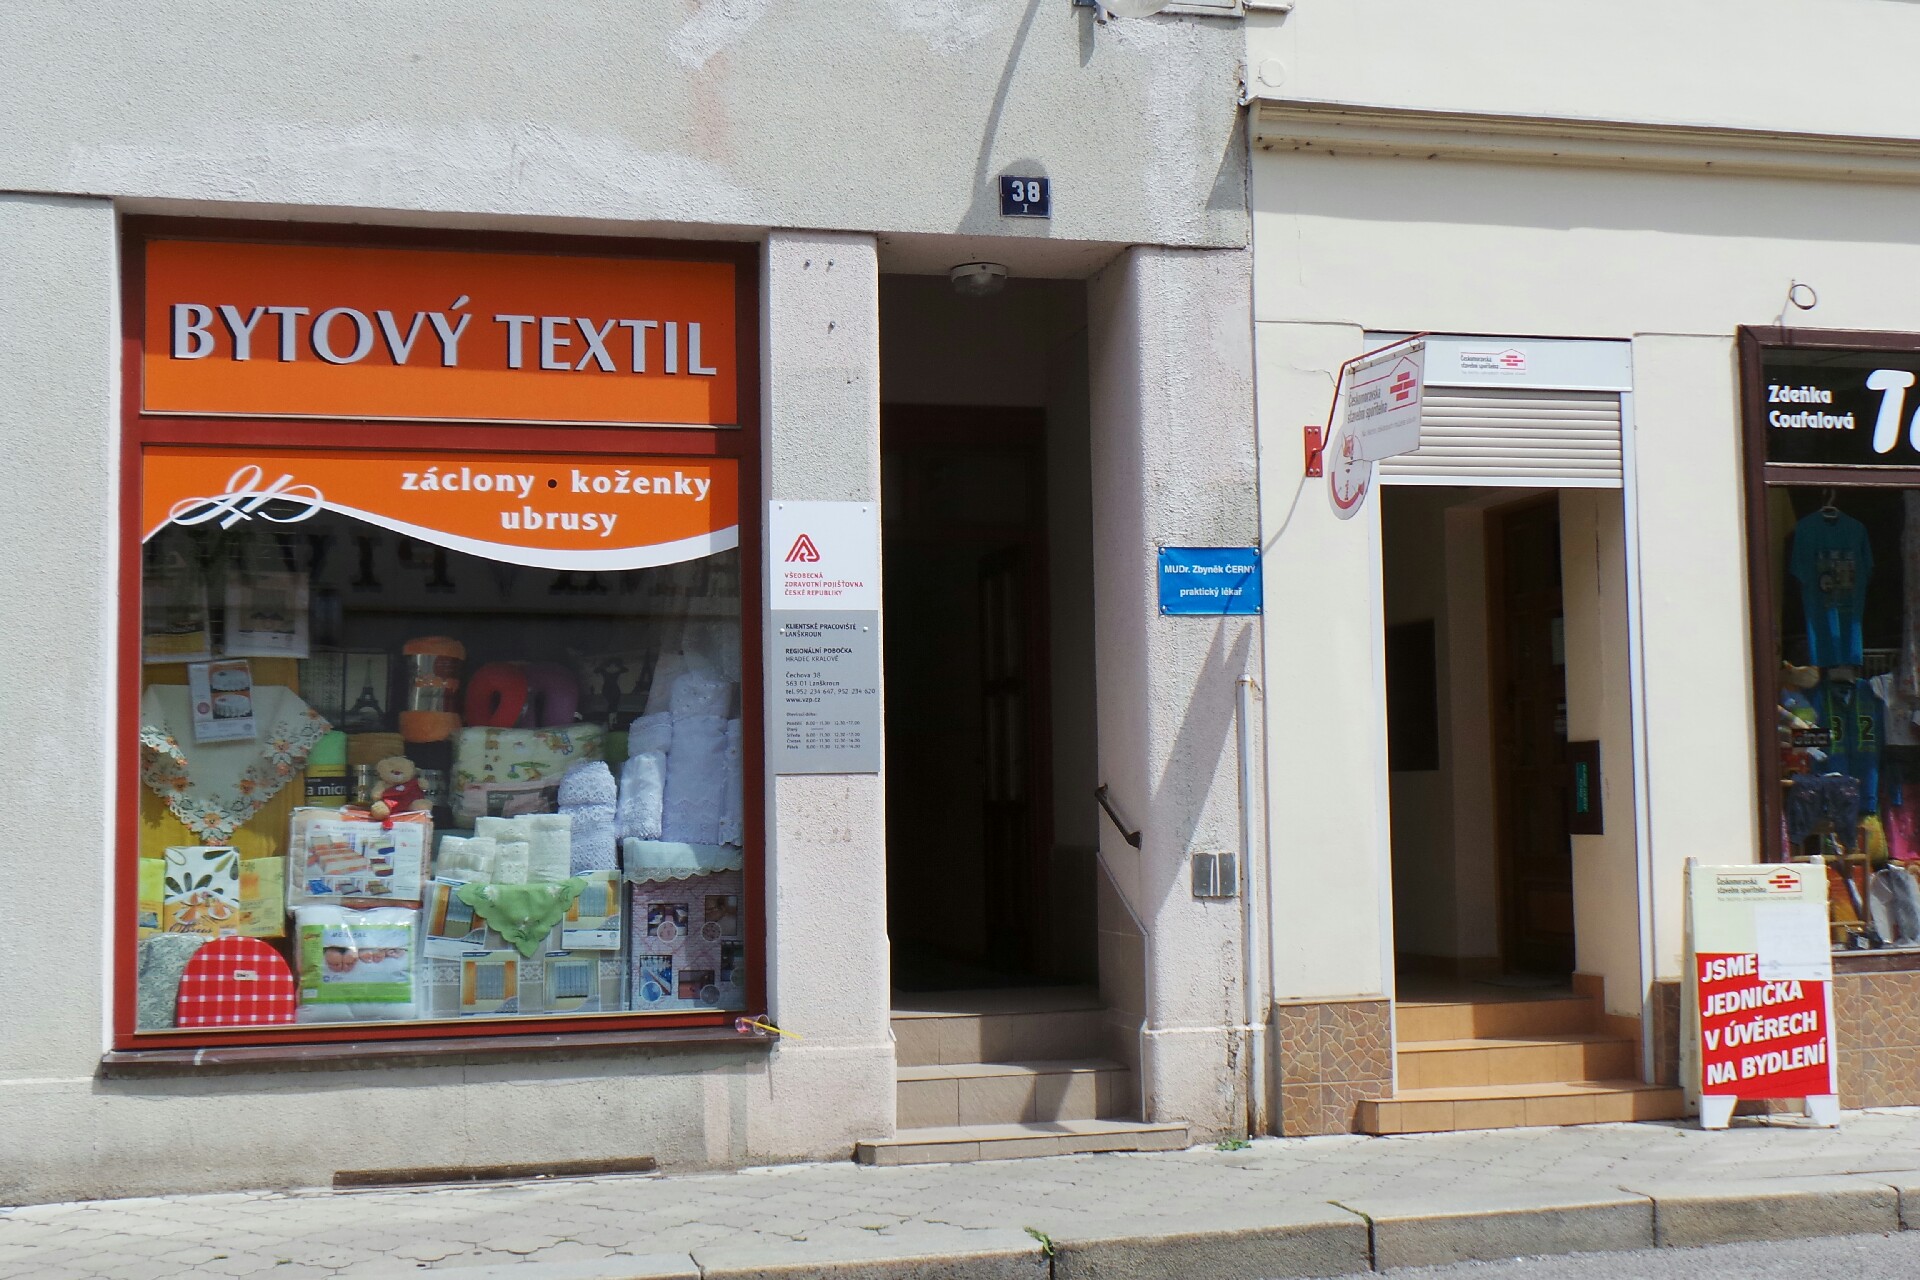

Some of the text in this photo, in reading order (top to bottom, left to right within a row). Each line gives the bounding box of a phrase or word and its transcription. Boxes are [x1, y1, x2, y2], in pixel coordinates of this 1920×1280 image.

[1011, 180, 1041, 203] 38
[169, 294, 718, 376] BYTOVÝ TEXTIL
[1768, 385, 1833, 404] Zdeňka
[1769, 410, 1856, 430] Coufalová
[401, 466, 711, 502] záclony koženky
[500, 505, 618, 537] ubrusy
[784, 571, 824, 579] VŠEOBECNÁ
[1164, 565, 1191, 574] MUDr.
[1192, 565, 1224, 575] Zbyněk
[784, 580, 864, 588] ZDRAVOTNÍ POJIŠŤOVNA
[1180, 587, 1243, 597] praktický lékař
[785, 622, 819, 630] KLIENTSKÉ
[785, 630, 822, 638] LANŠKROUN
[1701, 953, 1757, 983] JSME
[1702, 980, 1804, 1018] JEDNIČKA
[1704, 1010, 1818, 1051] V ÚVĚRECH
[1707, 1036, 1827, 1086] NA BYDLENÍ
